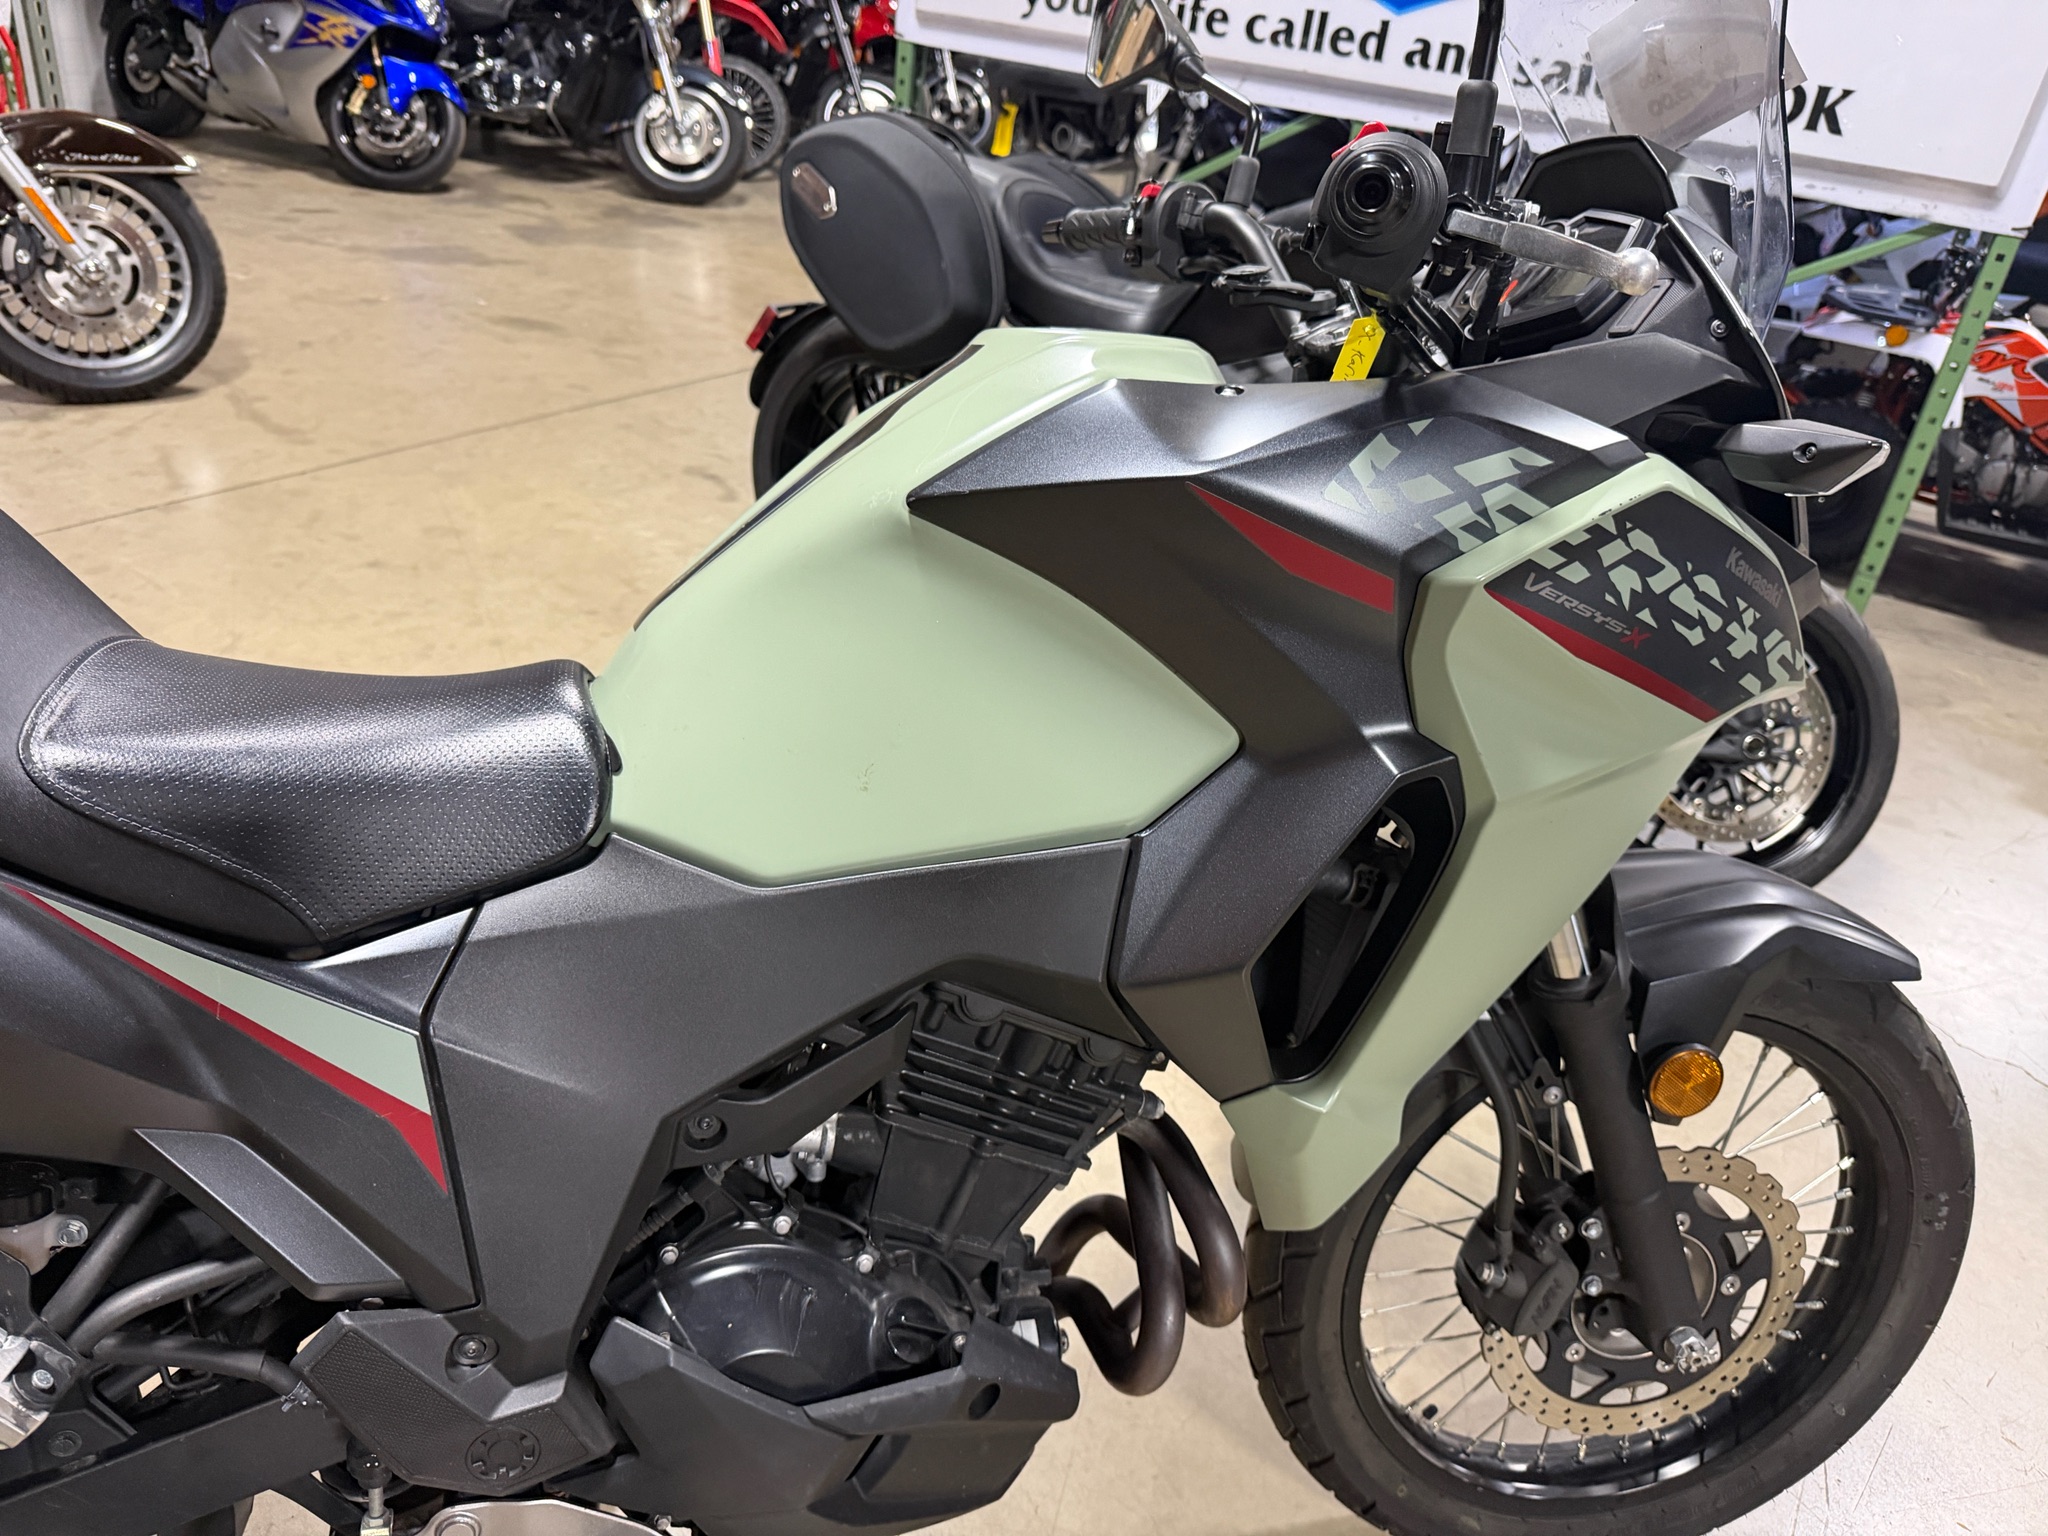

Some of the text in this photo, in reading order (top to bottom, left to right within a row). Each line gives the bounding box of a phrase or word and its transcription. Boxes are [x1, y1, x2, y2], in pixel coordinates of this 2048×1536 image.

[1167, 0, 1229, 38] ife
[1245, 9, 1391, 63] called
[1404, 37, 1473, 75] an
[1512, 52, 1604, 100] sai
[1524, 572, 1652, 649] VERSYS-X
[1725, 546, 1784, 609] Kawasaki
